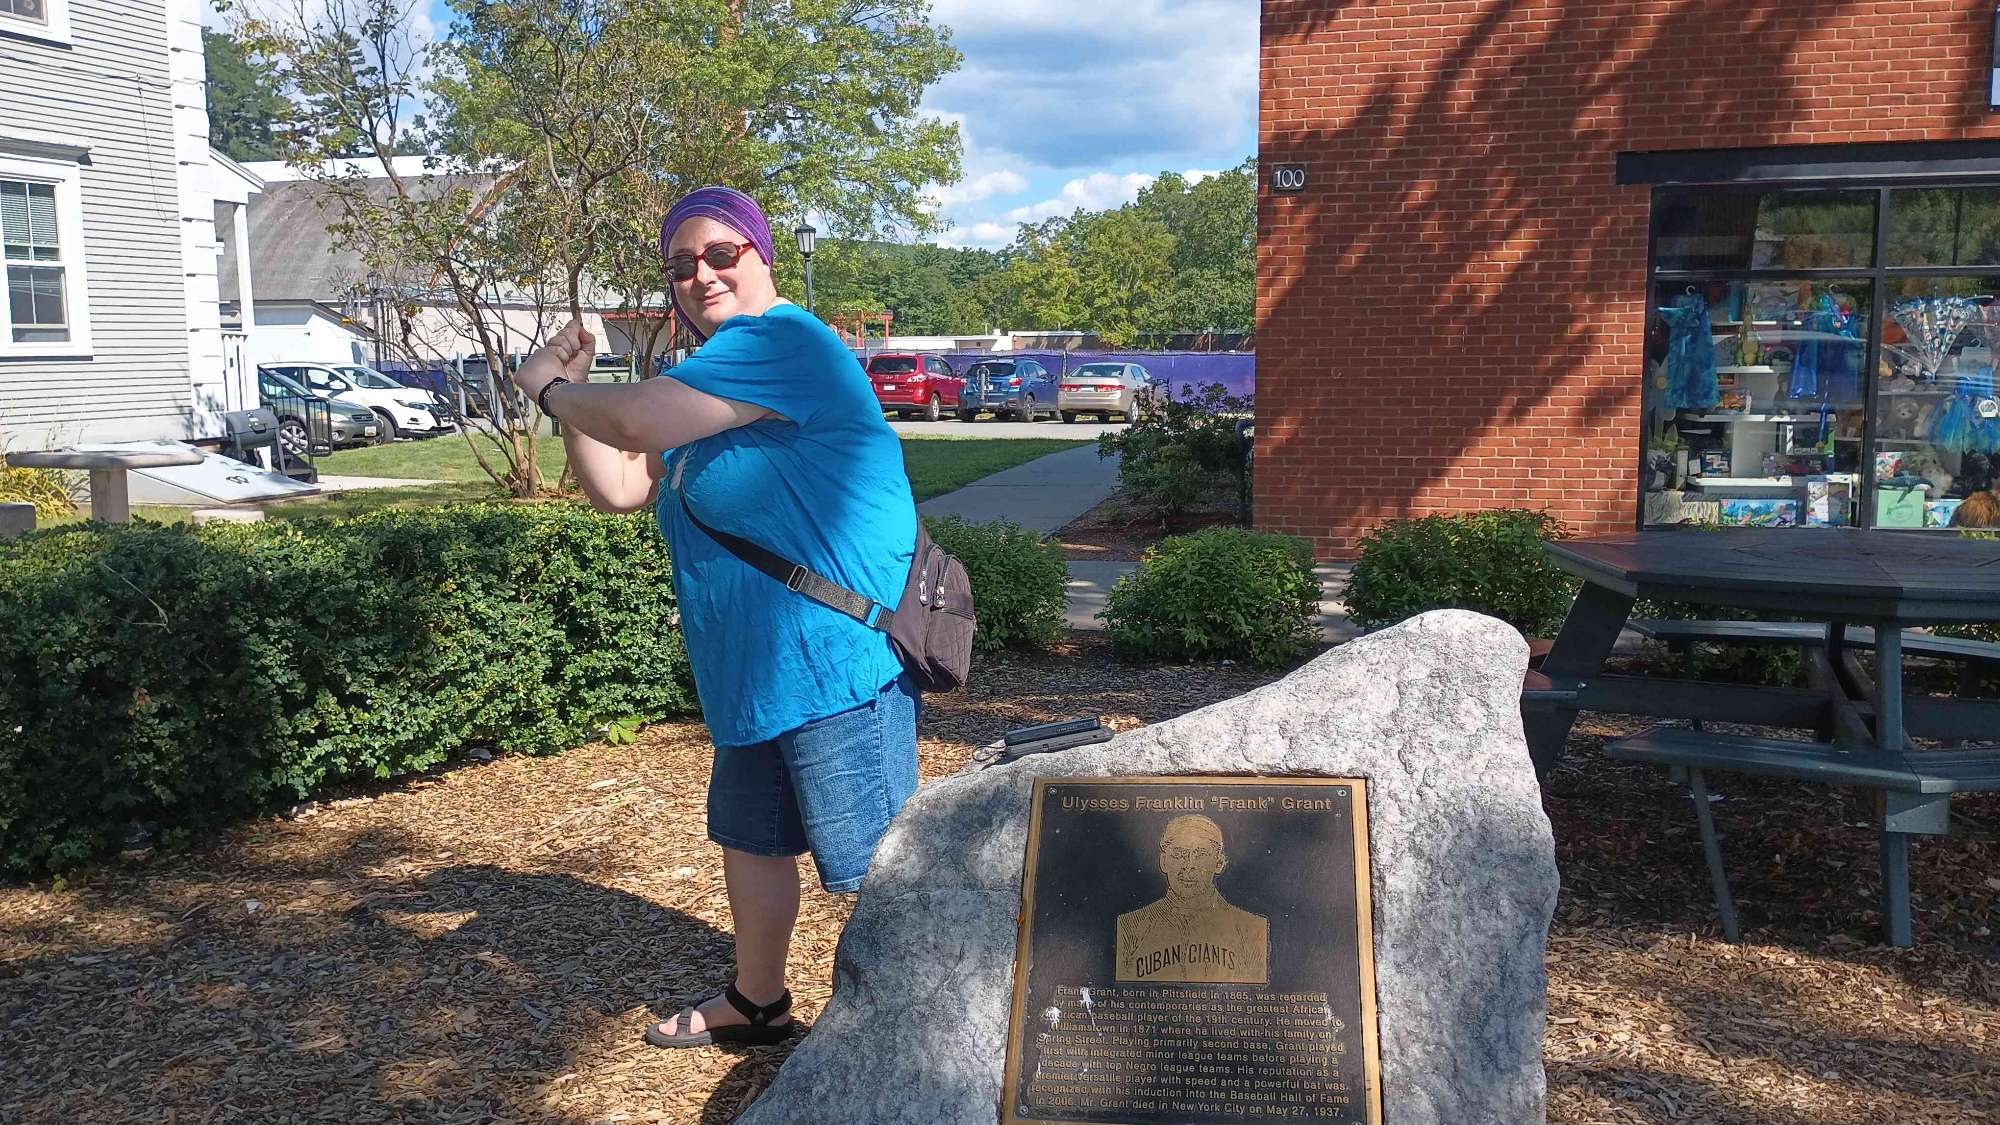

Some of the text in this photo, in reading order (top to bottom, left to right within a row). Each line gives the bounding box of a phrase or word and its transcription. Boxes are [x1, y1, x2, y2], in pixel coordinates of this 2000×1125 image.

[1275, 170, 1304, 187] 100
[1062, 796, 1129, 812] Ulysses
[1135, 796, 1204, 810] Franklin
[1281, 796, 1331, 811] Grant
[1137, 944, 1180, 978] CUBAN
[1090, 987, 1119, 998] Grant,
[1123, 989, 1145, 997] born
[1150, 989, 1158, 997] in
[1162, 989, 1207, 999] Pittsfield
[1211, 991, 1219, 999] in
[1224, 992, 1251, 1001] 1865,
[1256, 993, 1276, 1001] was
[1279, 993, 1327, 1004] regarded
[1053, 1000, 1065, 1010] by
[1110, 1000, 1124, 1008] his
[1128, 1001, 1207, 1012] contemporaries
[1211, 1004, 1222, 1012] as
[1227, 1003, 1242, 1012] the
[1246, 1004, 1289, 1015] greatest
[1293, 1005, 1332, 1014] African
[1041, 1010, 1343, 1028] erican baseball player of the 19th century. He moved to
[1120, 1024, 1129, 1033] in
[1133, 1024, 1156, 1033] 1871
[1161, 1026, 1190, 1034] where
[1195, 1027, 1207, 1035] he
[1212, 1027, 1235, 1036] lived
[1240, 1028, 1261, 1036] with
[1264, 1029, 1279, 1038] his
[1284, 1030, 1315, 1040] family
[1319, 1031, 1332, 1039] on
[1112, 1036, 1149, 1048] Playing
[1153, 1038, 1198, 1049] primarily
[1203, 1040, 1239, 1049] second
[1244, 1041, 1271, 1051] base,
[1276, 1042, 1305, 1051] Grant
[1309, 1042, 1344, 1054] played
[1090, 1048, 1142, 1061] integrated
[1146, 1050, 1174, 1059] minor
[1178, 1051, 1213, 1061] league
[1217, 1053, 1248, 1062] teams
[1252, 1054, 1285, 1063] before
[1289, 1054, 1328, 1066] playing
[1331, 1057, 1339, 1065] a
[1042, 1060, 1339, 1079] decade with top Negro league teams. His reputation as a
[1076, 1073, 1121, 1083] versatile
[1125, 1074, 1157, 1085] player
[1161, 1076, 1181, 1085] with
[1185, 1077, 1217, 1088] speed
[1221, 1078, 1240, 1087] and
[1255, 1079, 1300, 1090] powerful
[1304, 1081, 1321, 1090] bat
[1031, 1084, 1349, 1104] recognized with his induction into the Baseball Hall of Fame
[1036, 1096, 1045, 1105] in
[1080, 1099, 1097, 1108] Mr.
[1101, 1099, 1129, 1109] Grant
[1133, 1100, 1155, 1110] died
[1159, 1101, 1168, 1110] in
[1172, 1101, 1195, 1111] New
[1198, 1102, 1221, 1113] York
[1224, 1103, 1245, 1115] City
[1250, 1106, 1262, 1114] on
[1266, 1106, 1288, 1117] May
[1292, 1106, 1309, 1117] 27,
[1314, 1107, 1344, 1118] 1937.
